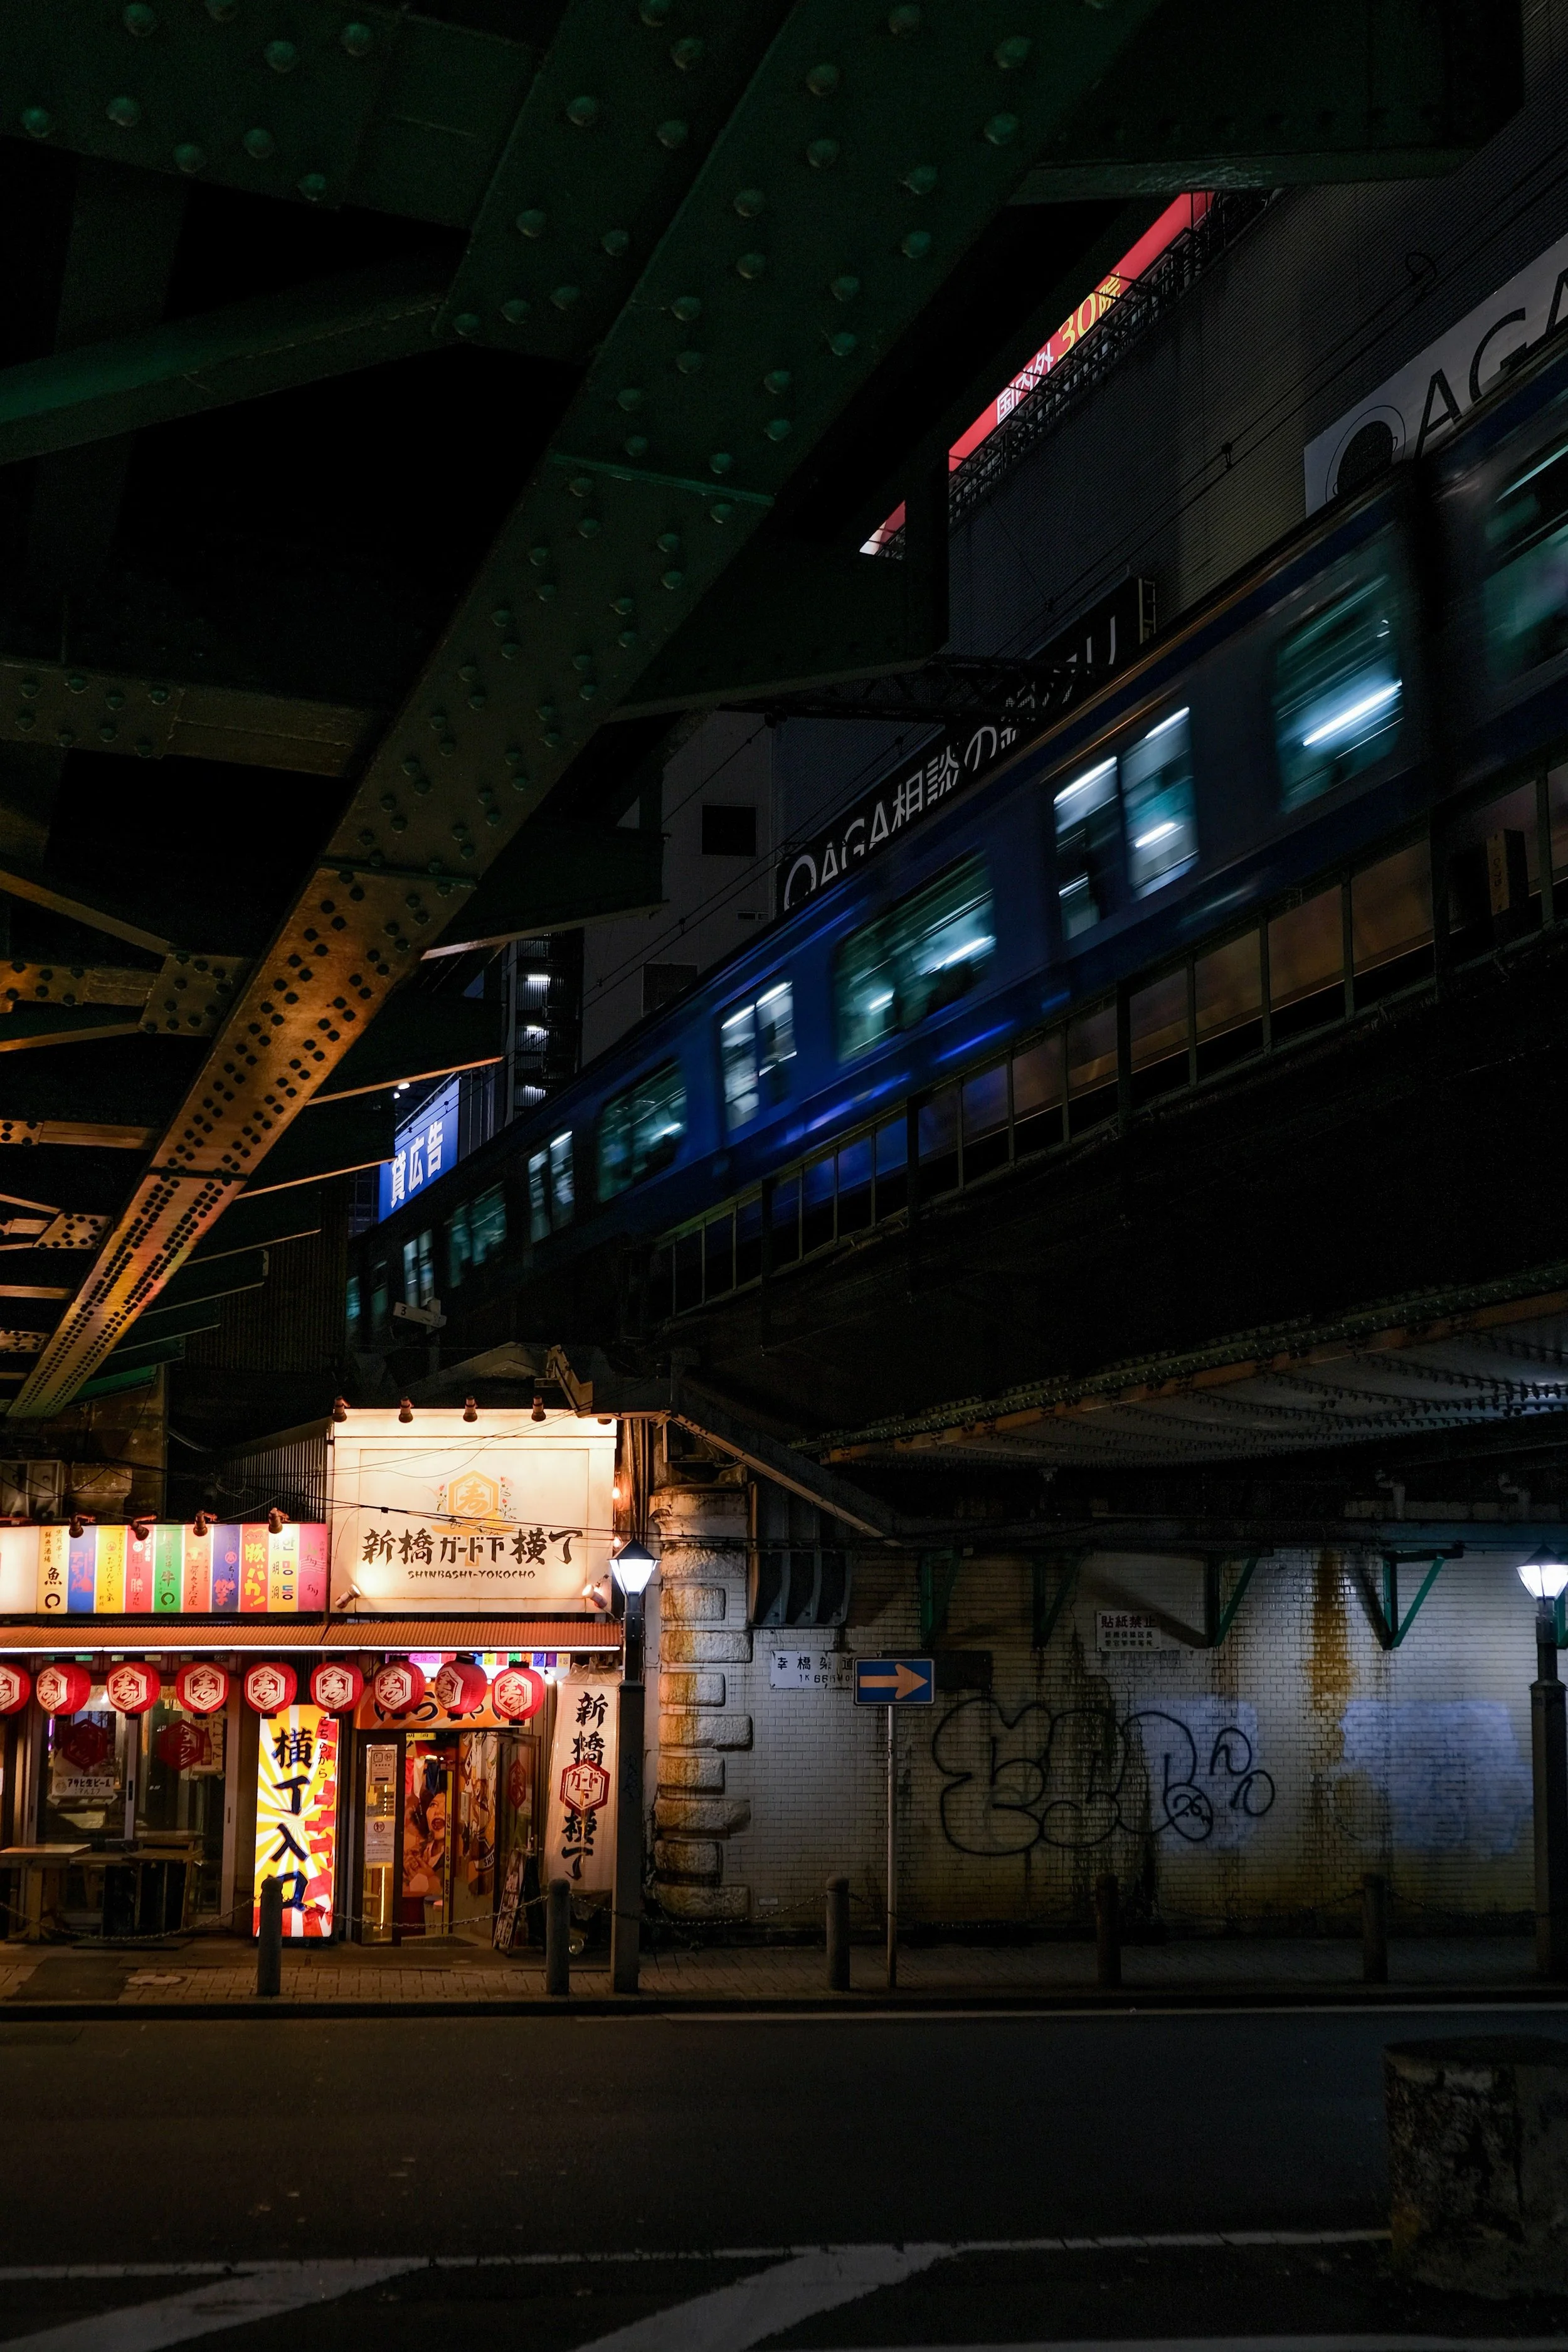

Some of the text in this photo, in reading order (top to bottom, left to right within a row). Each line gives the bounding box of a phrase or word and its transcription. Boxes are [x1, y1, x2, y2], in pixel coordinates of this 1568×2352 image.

[391, 1120, 443, 1209] 貸広告
[401, 1306, 406, 1316] 3
[362, 1528, 583, 1565] 新橋ガード下横丁
[408, 1570, 536, 1580] SHINBASHI-YOKOCHO
[1101, 1616, 1157, 1628] 貼紙禁止
[318, 1716, 330, 1777] こちらから
[569, 1692, 608, 1766] 新橋
[68, 1778, 110, 1787] アサヒ生ビール
[270, 1726, 312, 1912] 横丁入口
